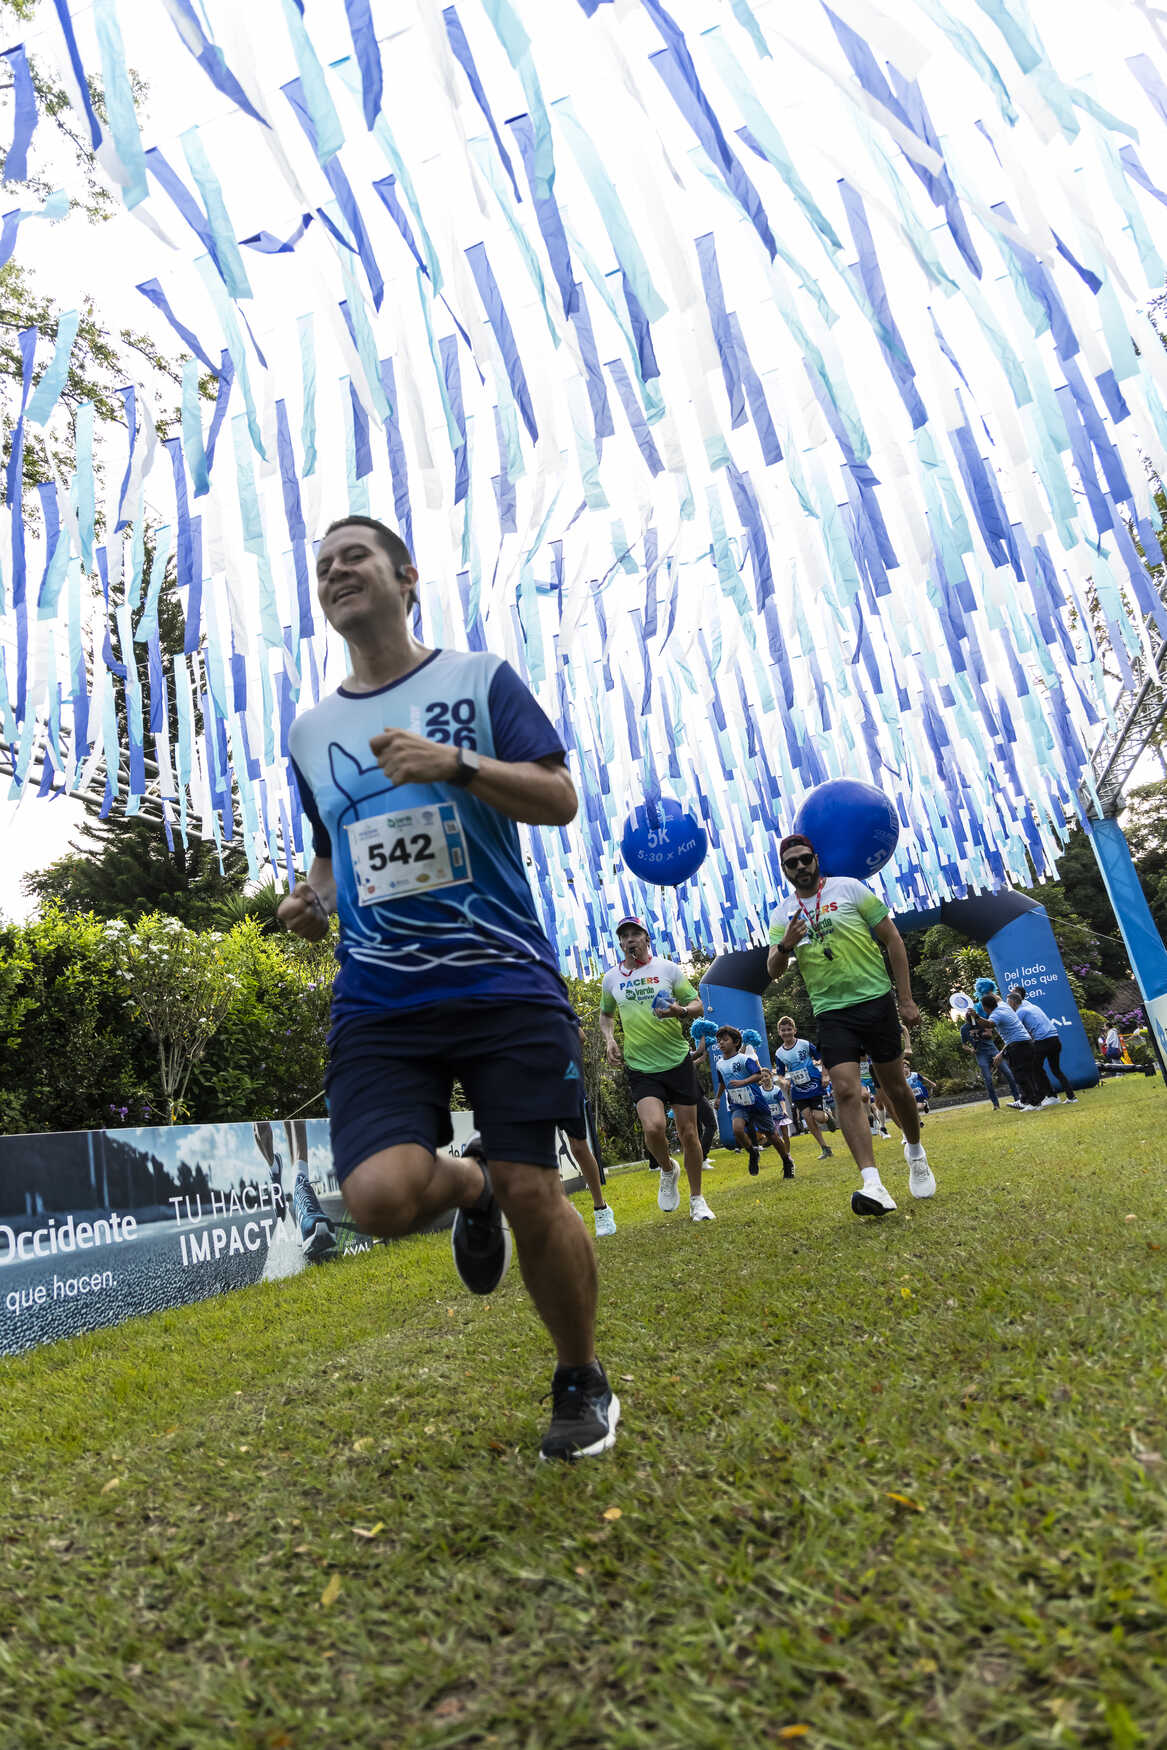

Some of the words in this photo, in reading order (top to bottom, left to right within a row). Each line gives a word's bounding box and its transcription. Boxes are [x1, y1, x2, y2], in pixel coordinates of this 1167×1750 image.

[425, 698, 475, 727] 20
[647, 828, 670, 848] 5K
[368, 833, 435, 871] 542
[637, 850, 663, 862] 5:30
[678, 839, 697, 855] Km
[619, 976, 660, 991] PACERS
[1004, 968, 1019, 982] Del
[1021, 963, 1046, 976] lado
[1021, 978, 1037, 988] los
[1039, 973, 1058, 984] que
[168, 1193, 202, 1226] TU
[210, 1183, 289, 1220] HACER,
[0, 1212, 138, 1262] Occidente
[343, 1241, 371, 1257] AVAL
[6, 1285, 47, 1316] que
[53, 1271, 117, 1300] hacen.
